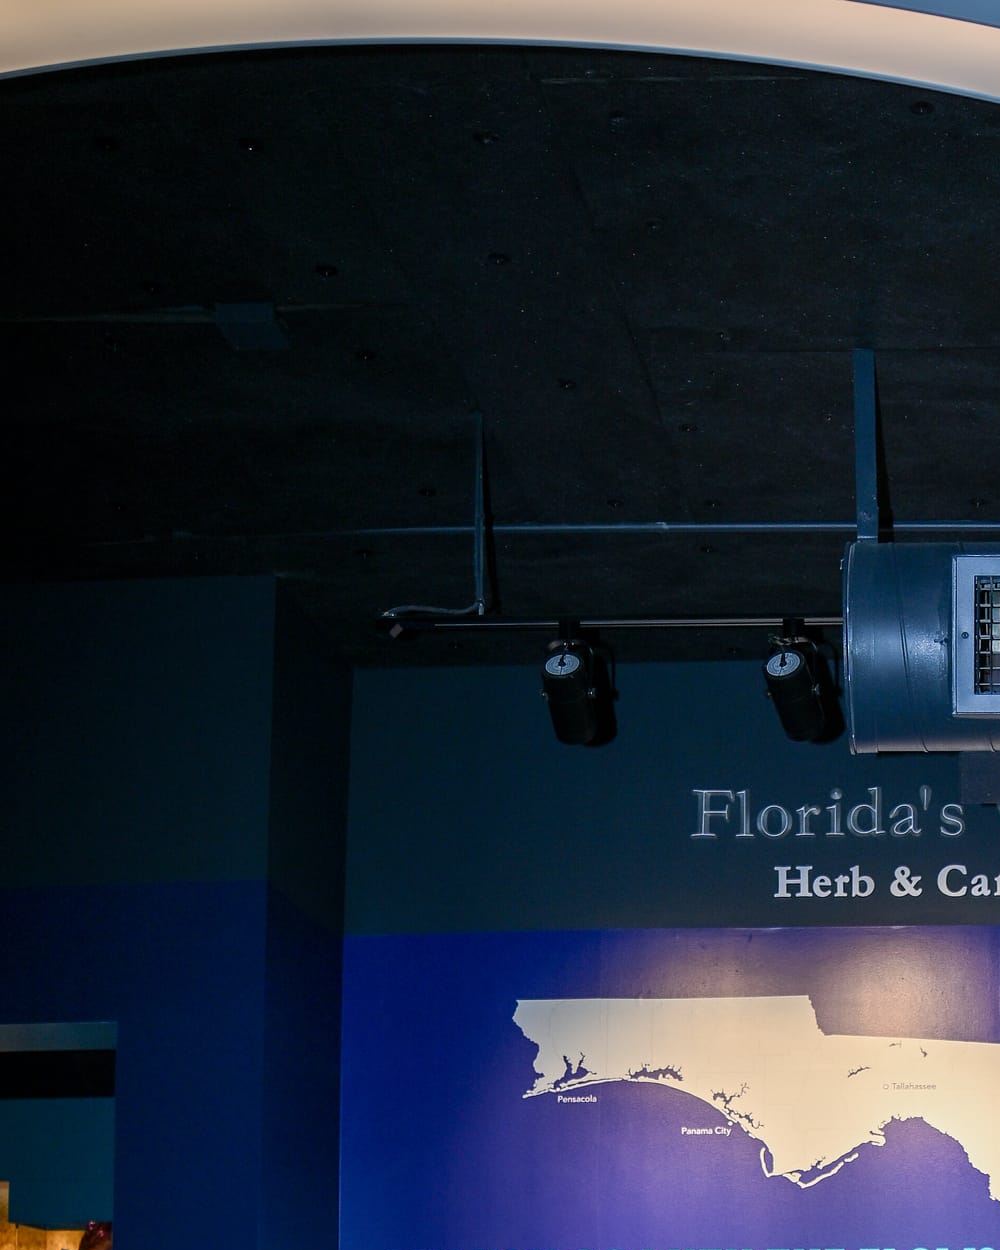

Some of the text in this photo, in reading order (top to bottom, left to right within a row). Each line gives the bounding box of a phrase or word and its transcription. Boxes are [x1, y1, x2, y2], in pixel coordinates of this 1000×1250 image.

[693, 789, 964, 837] Florida's
[774, 866, 875, 897] Herb
[890, 866, 922, 896] &
[557, 1095, 597, 1103] Pensacola
[681, 1127, 731, 1136] Panama City
